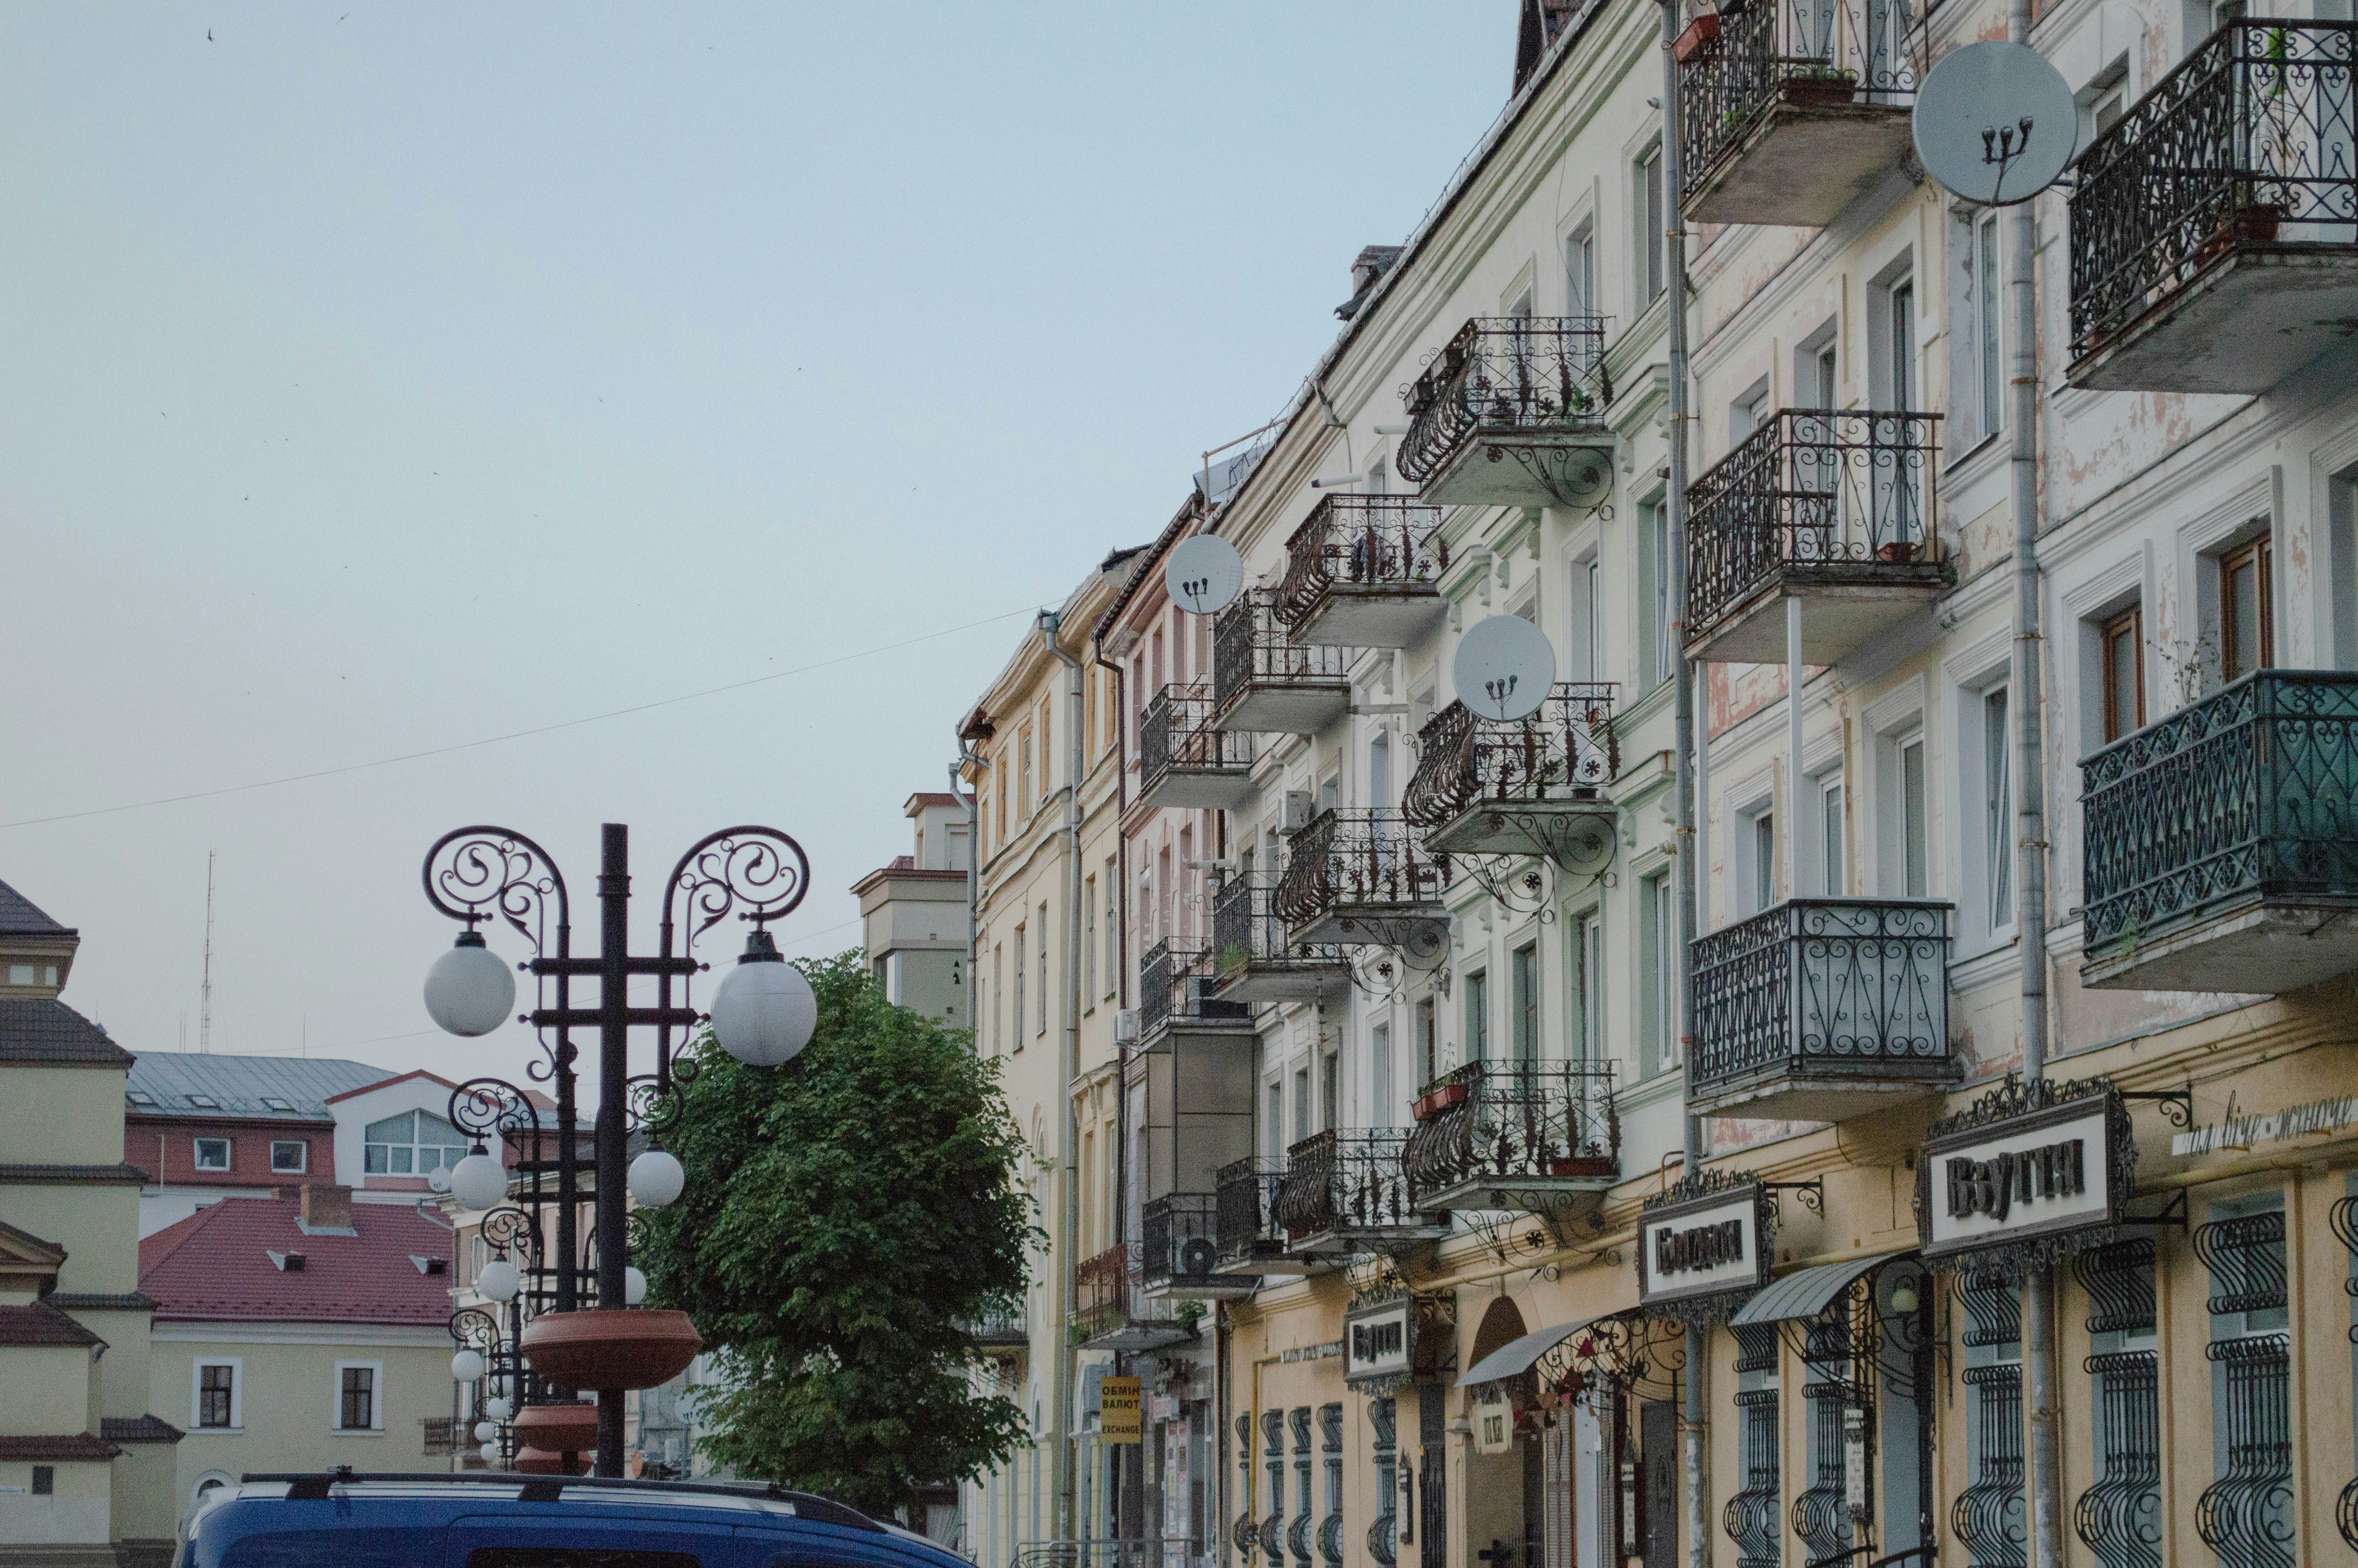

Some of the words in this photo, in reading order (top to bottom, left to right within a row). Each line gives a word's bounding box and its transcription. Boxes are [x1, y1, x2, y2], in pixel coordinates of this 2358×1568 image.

[1102, 1386, 1140, 1396] ОБМІН
[1102, 1399, 1139, 1409] ВАЛЮТ
[1102, 1425, 1139, 1434] EXCHANGE
